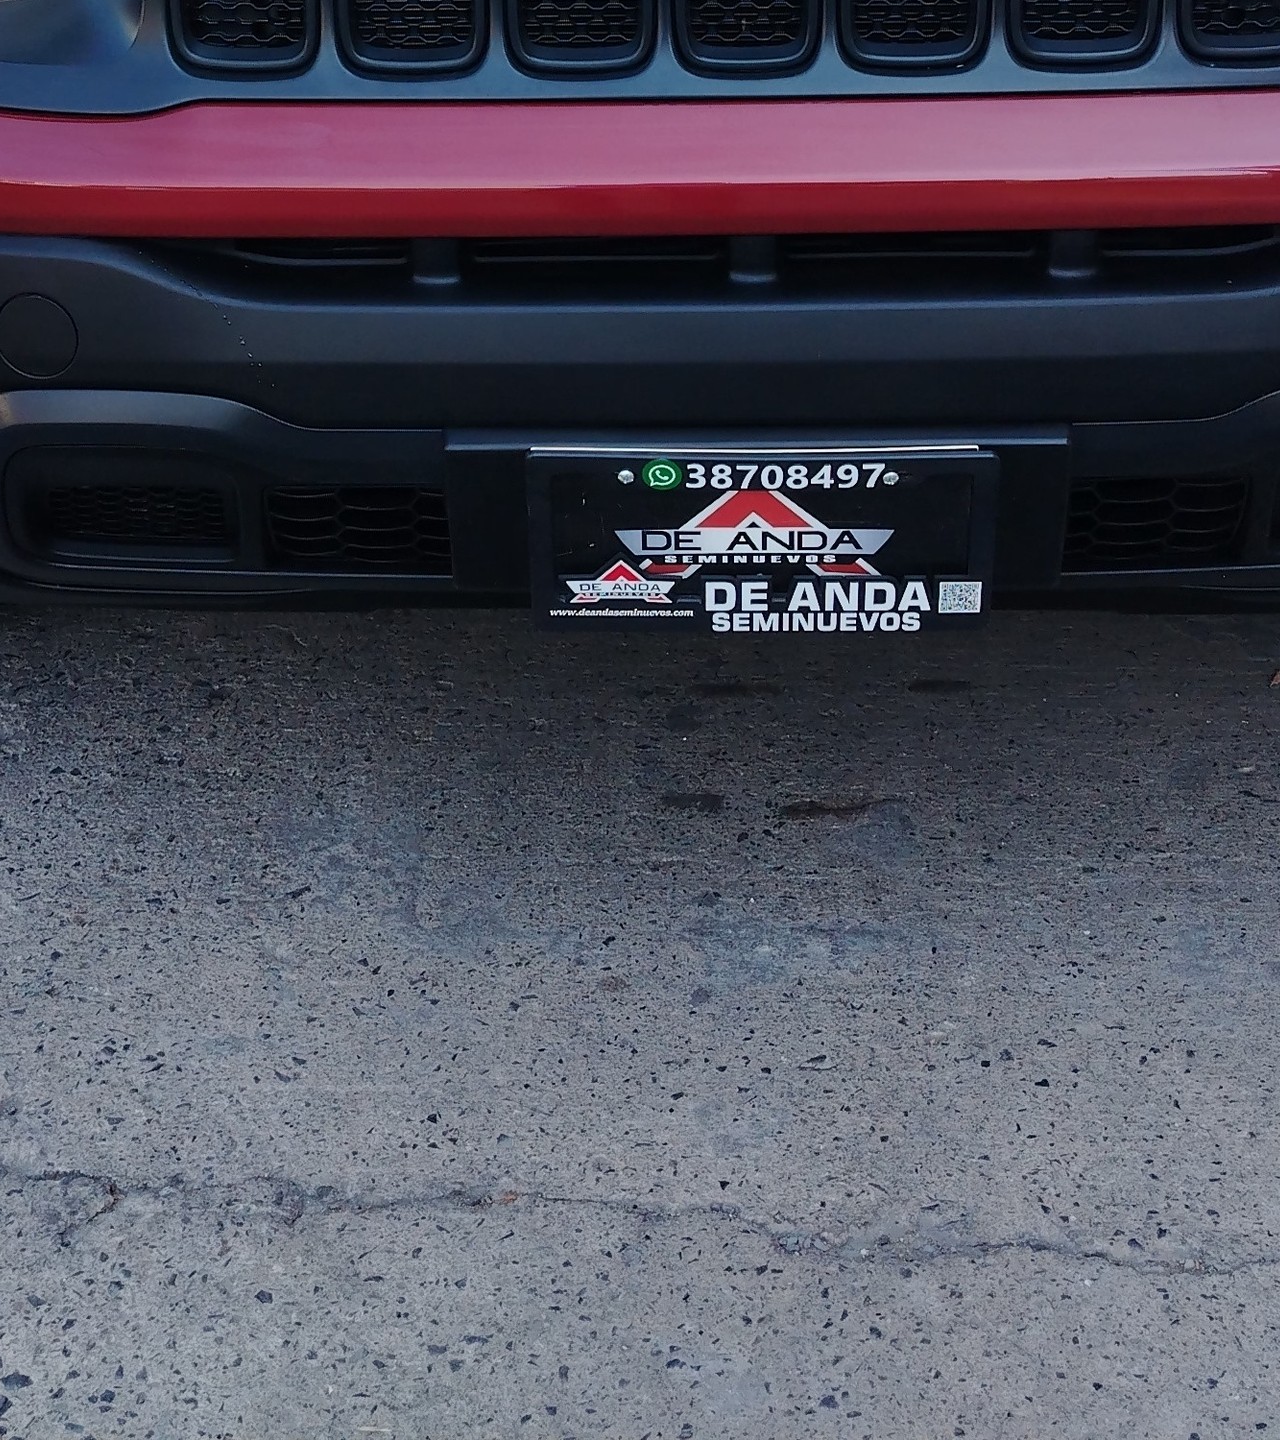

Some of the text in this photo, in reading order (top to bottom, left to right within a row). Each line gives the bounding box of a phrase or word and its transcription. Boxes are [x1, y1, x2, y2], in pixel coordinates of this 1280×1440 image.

[685, 463, 886, 490] 38708497
[641, 530, 863, 551] DE ANDA
[664, 554, 837, 564] SEMINUEVOS
[579, 583, 661, 592] DE ANDA
[704, 581, 931, 612] DE ANDA
[549, 608, 694, 617] www.deandaseminuevos.com
[711, 611, 921, 632] SEMINUEVOS
